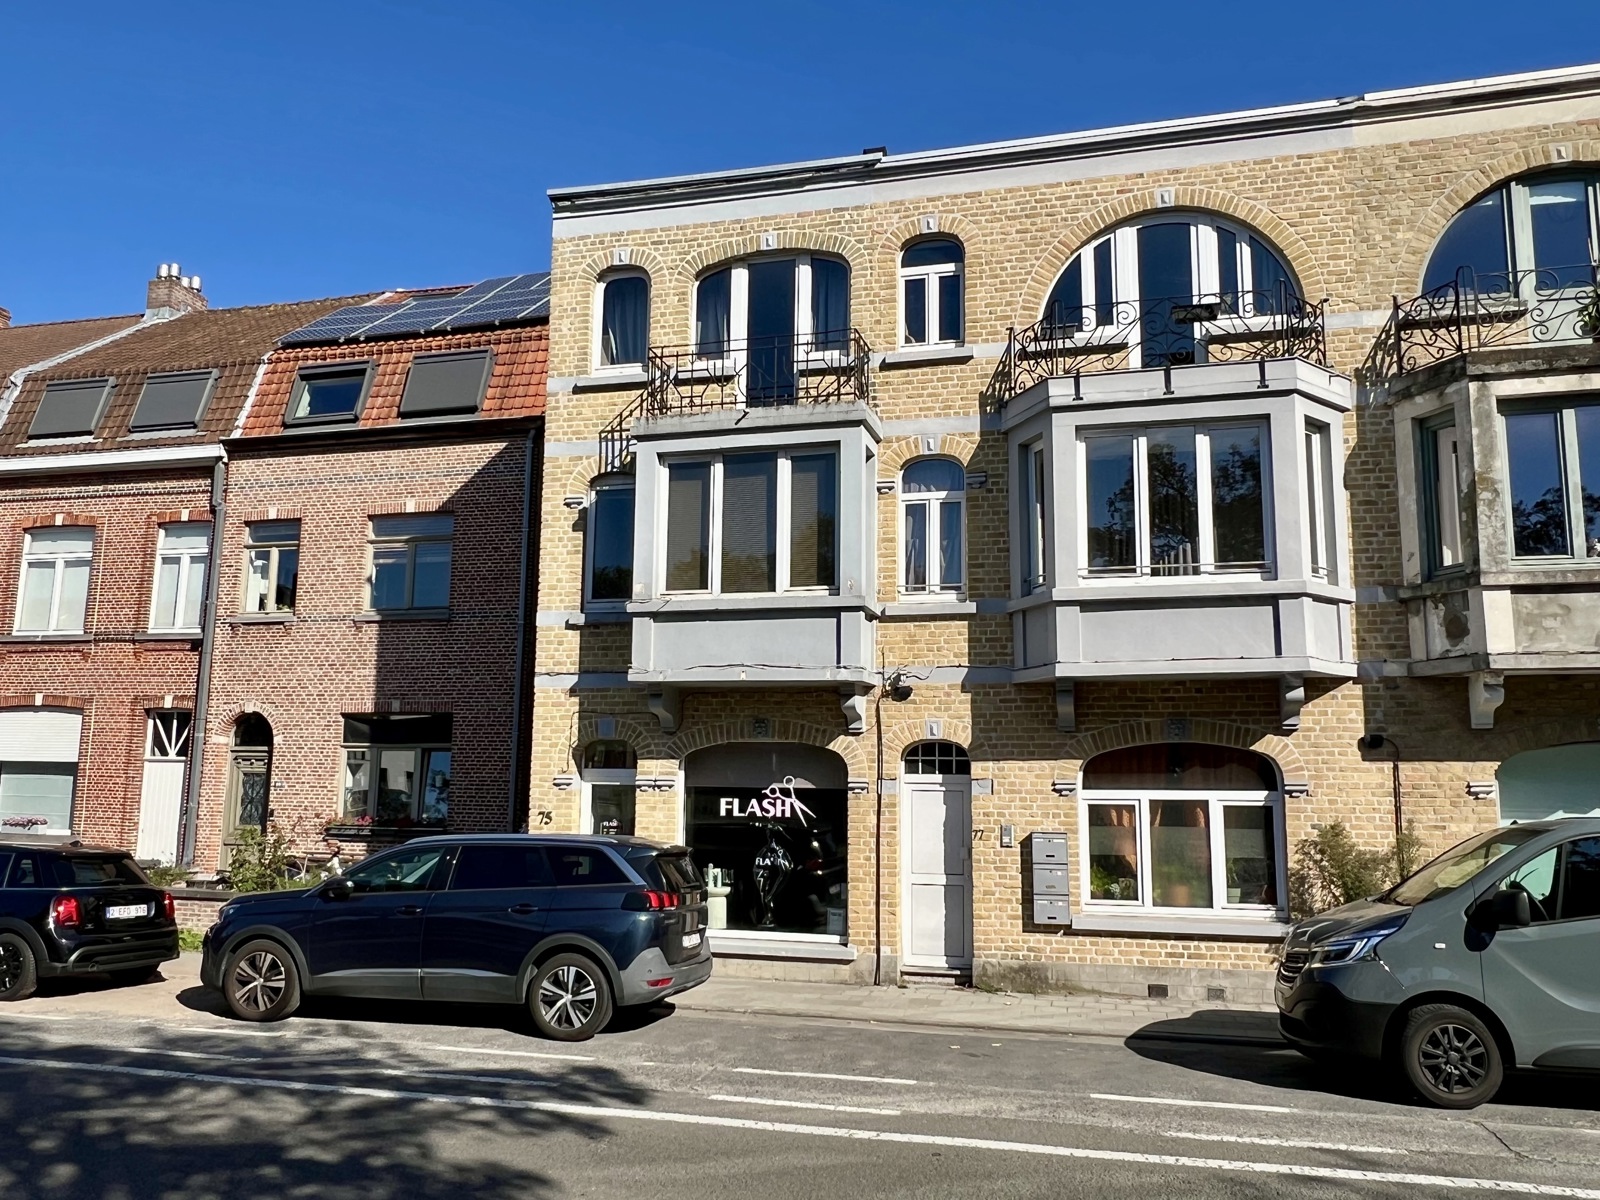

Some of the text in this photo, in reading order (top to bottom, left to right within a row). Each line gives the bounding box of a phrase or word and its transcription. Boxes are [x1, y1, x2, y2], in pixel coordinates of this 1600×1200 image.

[720, 798, 791, 817] FLASH
[537, 811, 553, 825] 75
[972, 829, 984, 840] 77
